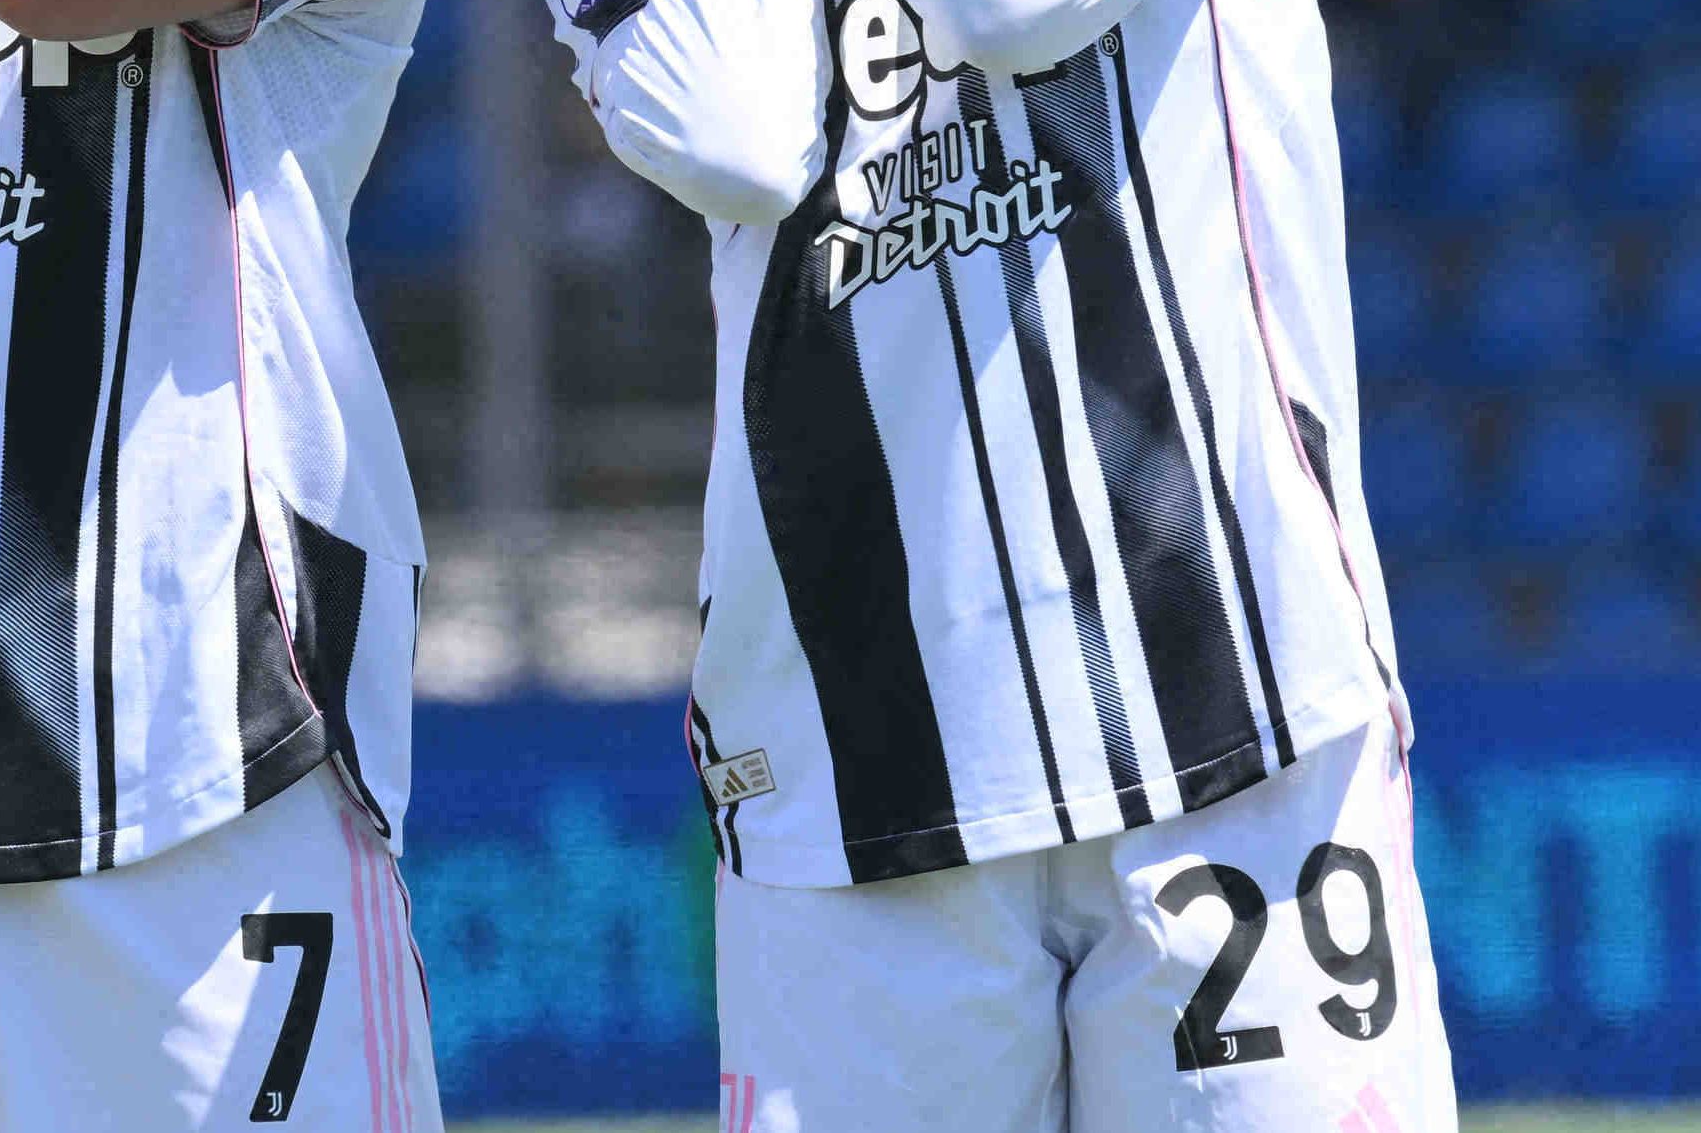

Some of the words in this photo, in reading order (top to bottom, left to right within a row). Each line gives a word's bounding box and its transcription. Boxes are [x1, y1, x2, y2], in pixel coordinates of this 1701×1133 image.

[814, 160, 1072, 310] Detroit
[865, 119, 988, 212] VISIT
[241, 912, 334, 1122] 7
[1154, 841, 1397, 1072] 29
